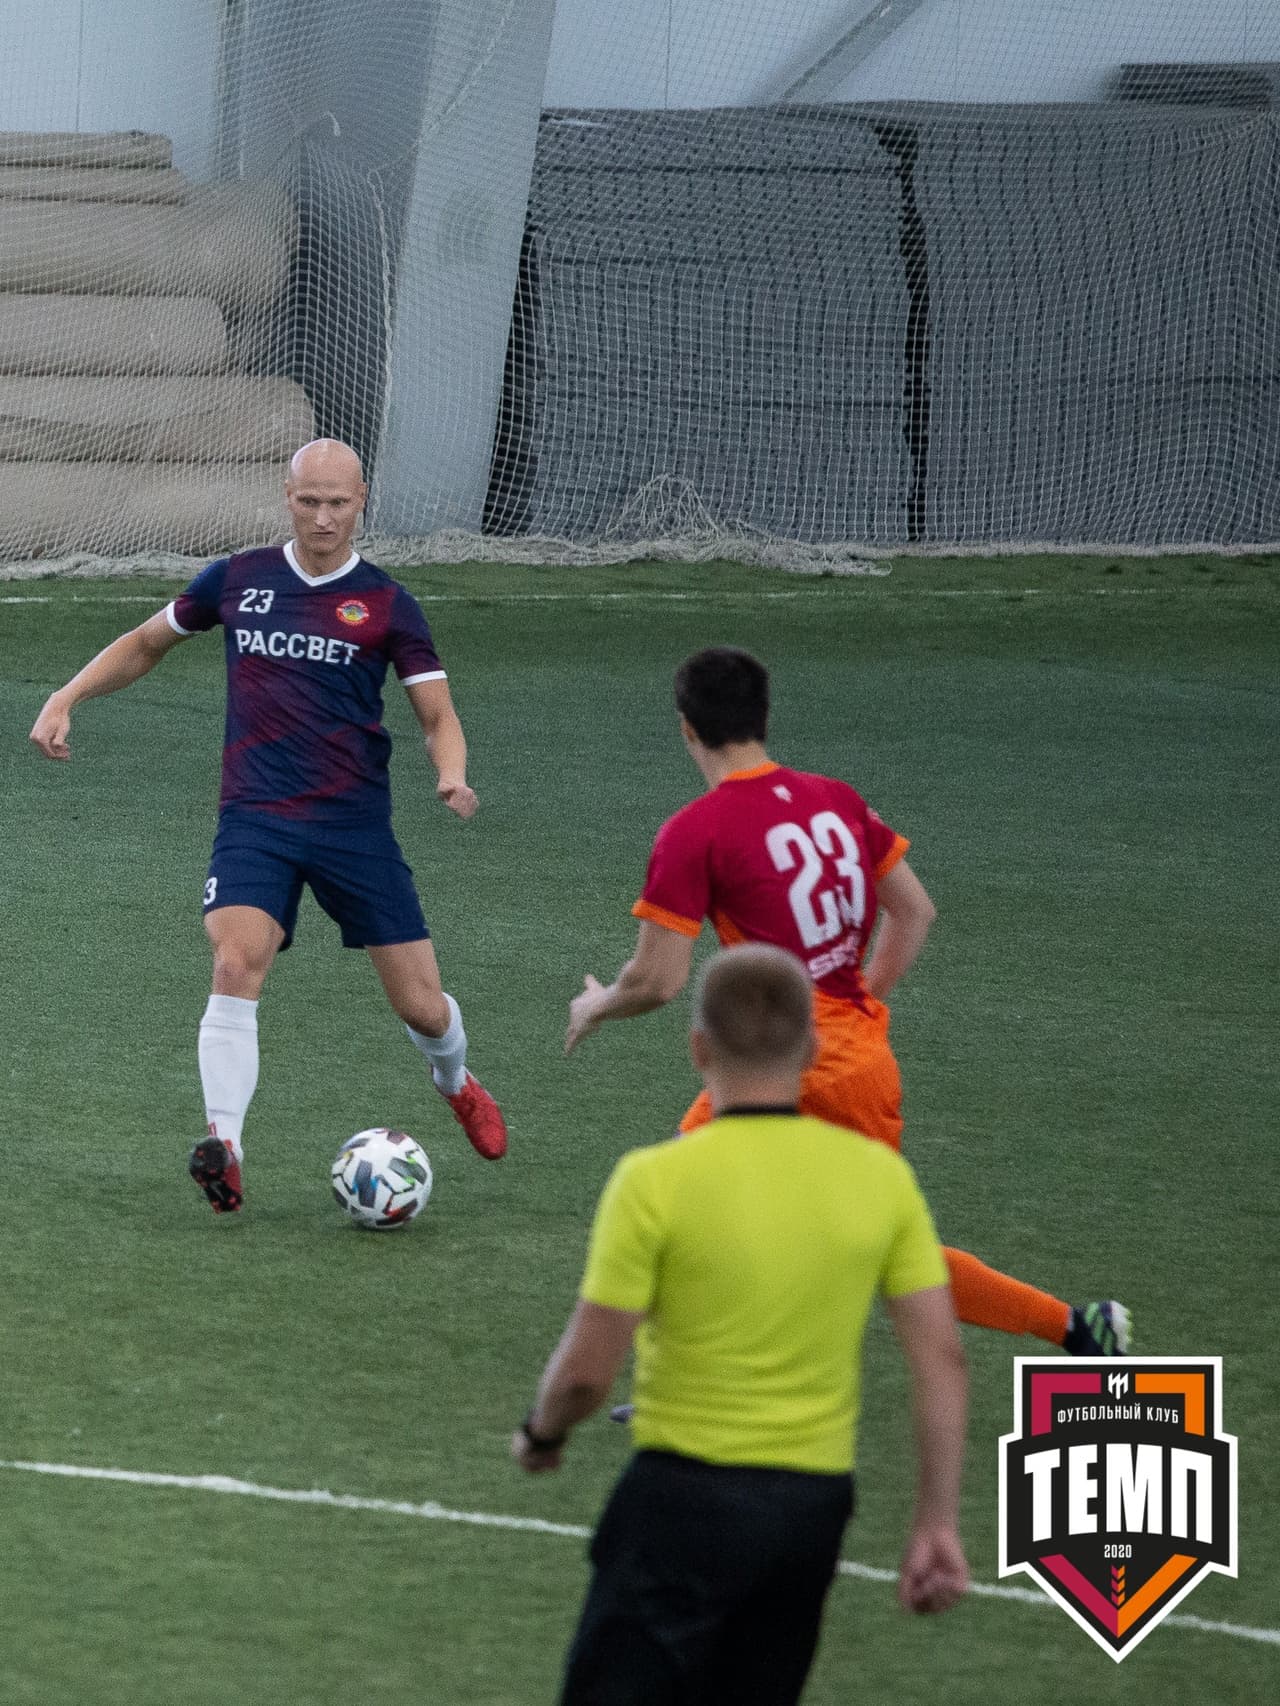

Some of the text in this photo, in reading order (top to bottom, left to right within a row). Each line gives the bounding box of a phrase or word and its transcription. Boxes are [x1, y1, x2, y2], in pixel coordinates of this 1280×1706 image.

[238, 588, 275, 614] 23
[235, 629, 360, 665] РАССВЕТ
[765, 811, 866, 949] 23
